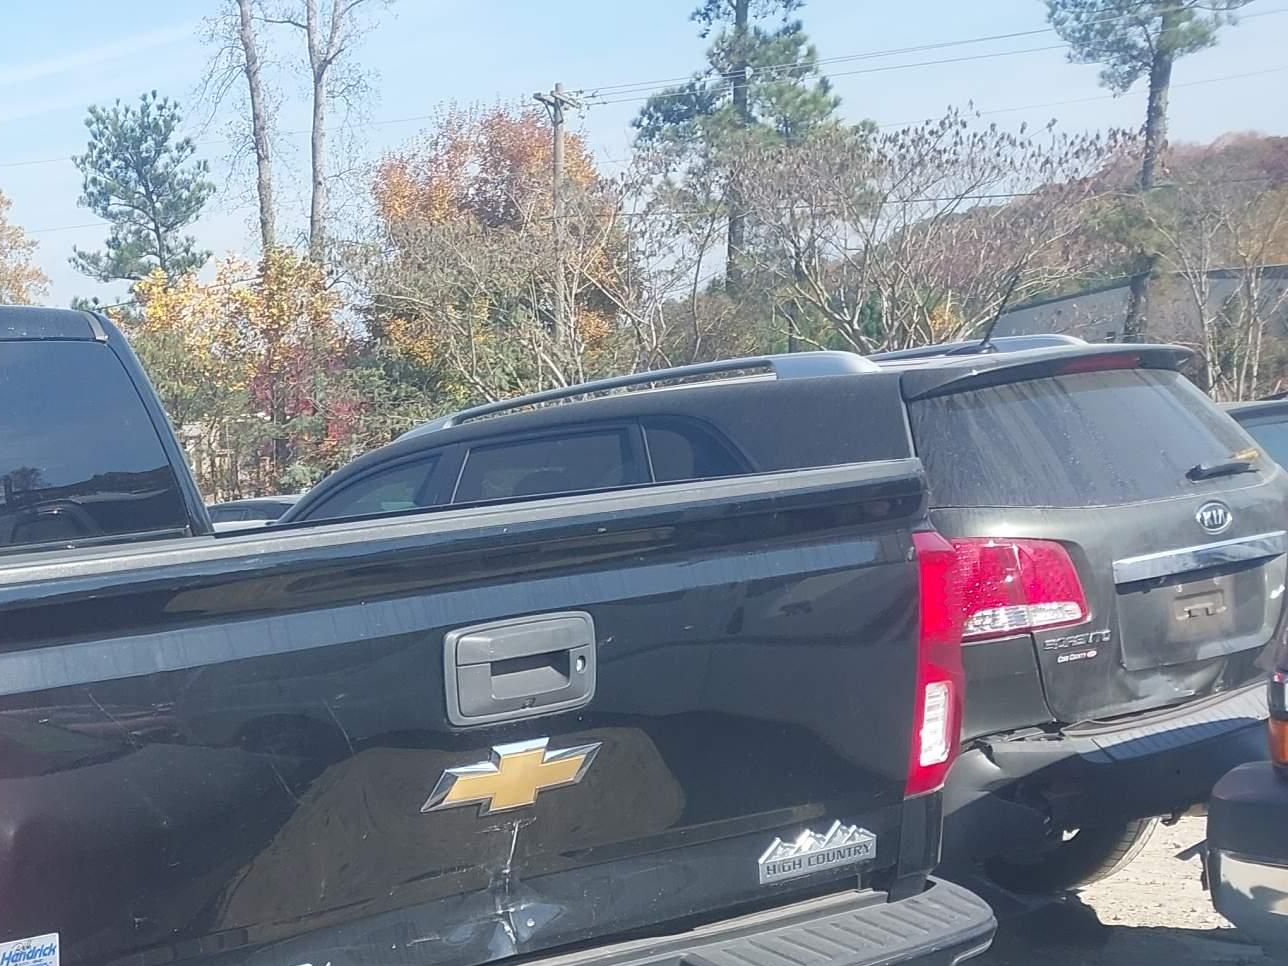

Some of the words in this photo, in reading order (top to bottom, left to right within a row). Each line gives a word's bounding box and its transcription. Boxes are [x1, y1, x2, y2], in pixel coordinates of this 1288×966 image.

[1202, 509, 1226, 527] KIA
[766, 859, 802, 876] HIGH
[808, 843, 872, 867] COUNTRY
